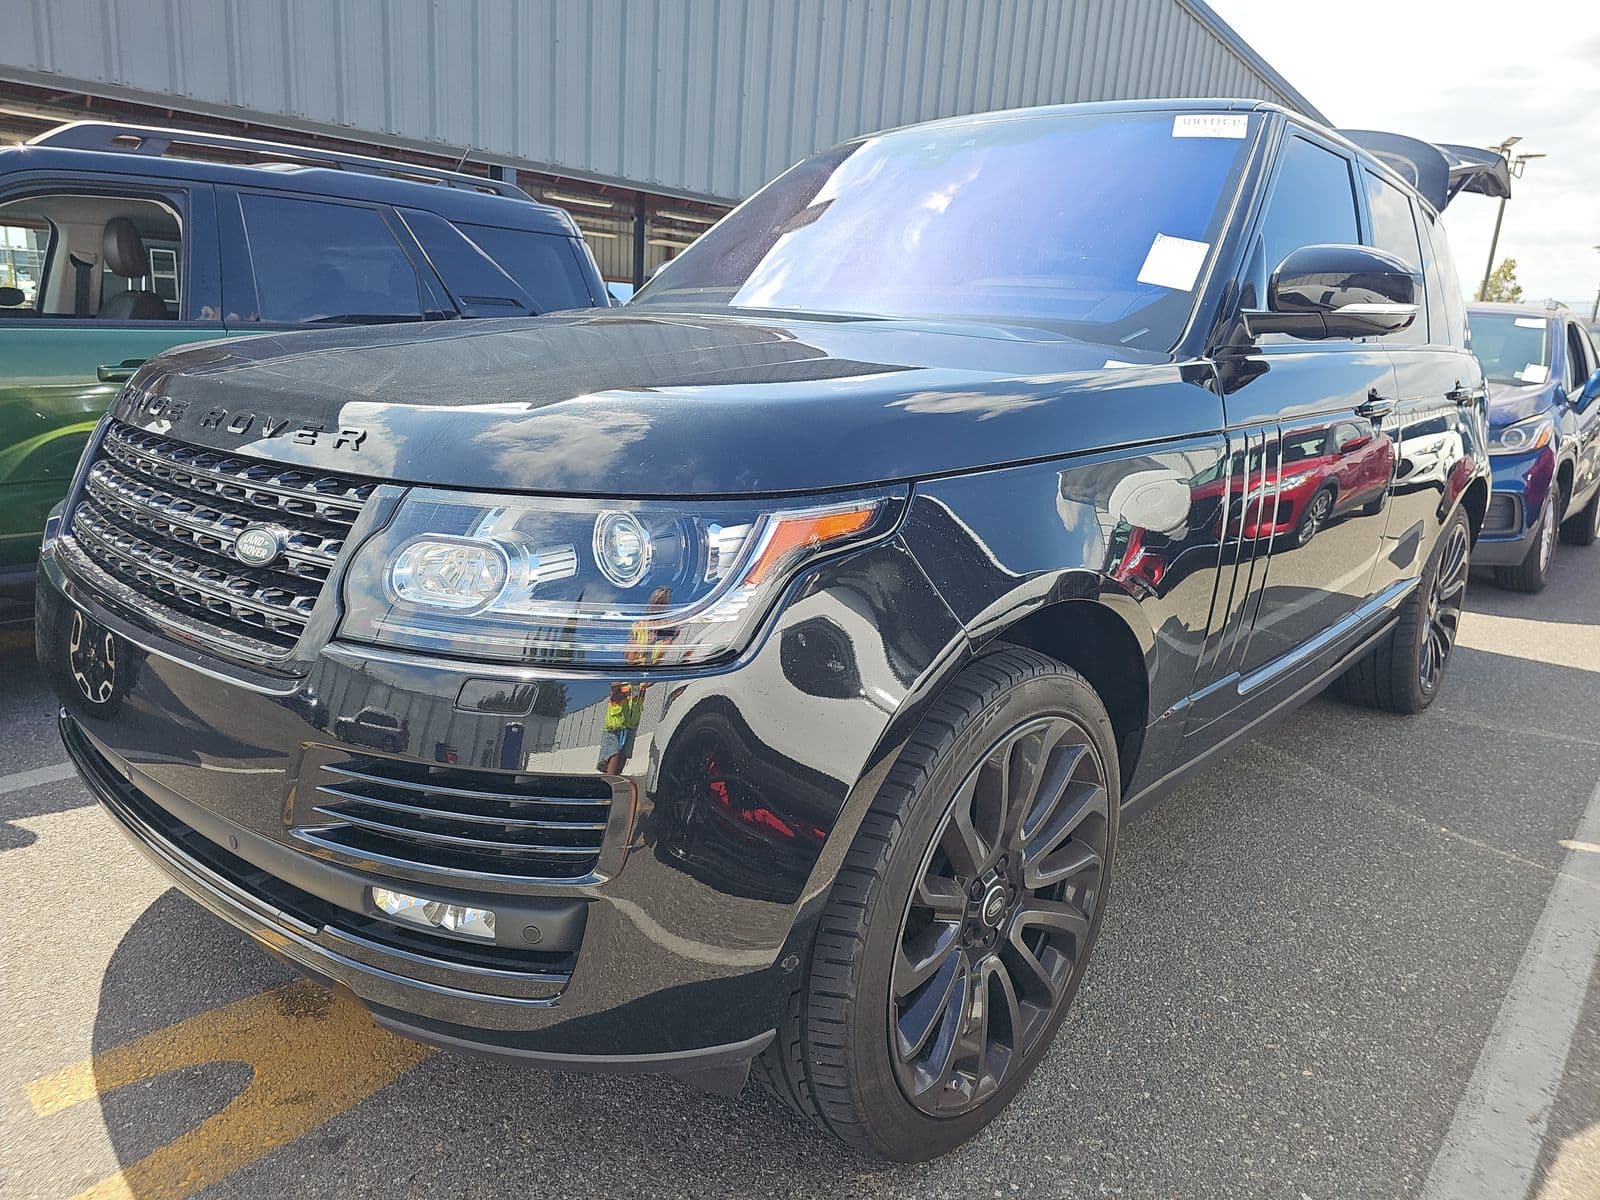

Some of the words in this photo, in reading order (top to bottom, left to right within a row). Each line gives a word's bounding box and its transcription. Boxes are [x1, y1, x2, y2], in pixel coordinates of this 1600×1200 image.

[200, 406, 368, 452] ROVER
[243, 533, 266, 546] LAND
[241, 543, 268, 559] ROVER
